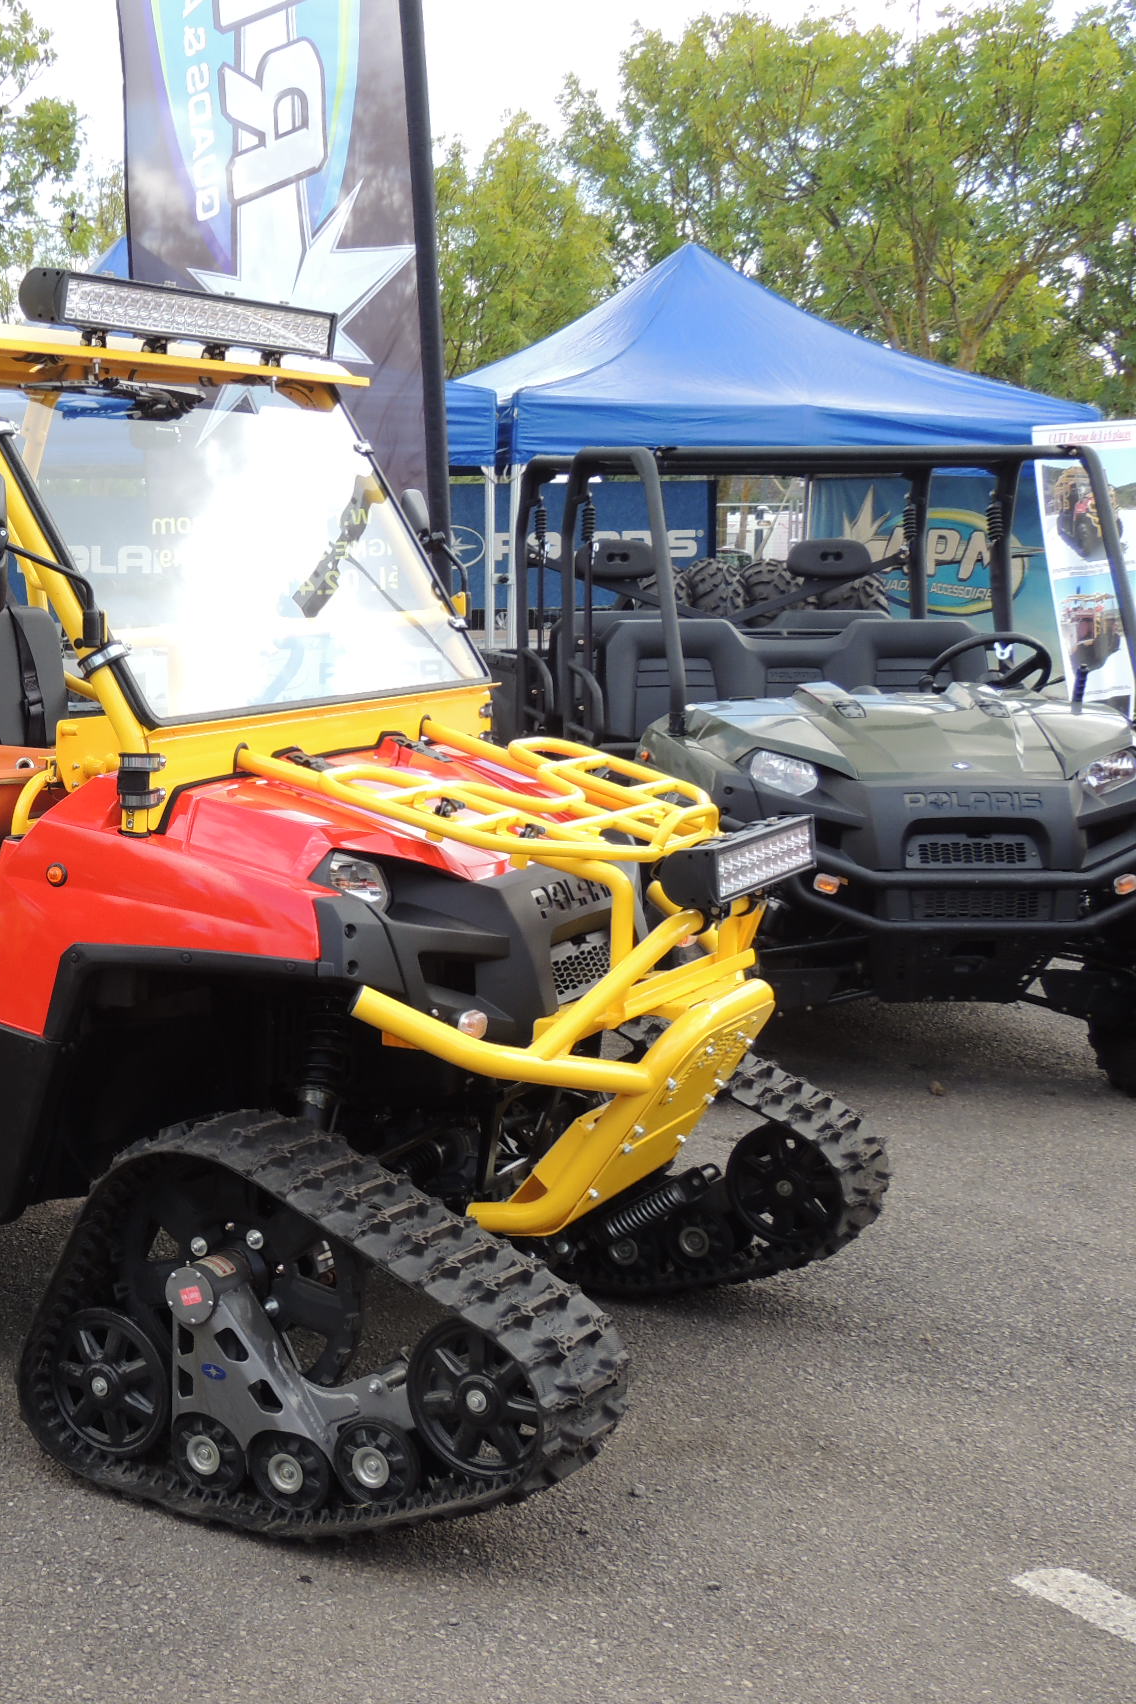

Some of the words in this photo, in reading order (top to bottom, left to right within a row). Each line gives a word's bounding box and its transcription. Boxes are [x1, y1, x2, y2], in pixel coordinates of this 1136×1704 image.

[929, 583, 993, 600] ACCESSOIRE
[903, 791, 1043, 811] POLARIS
[530, 879, 613, 919] POLAR
